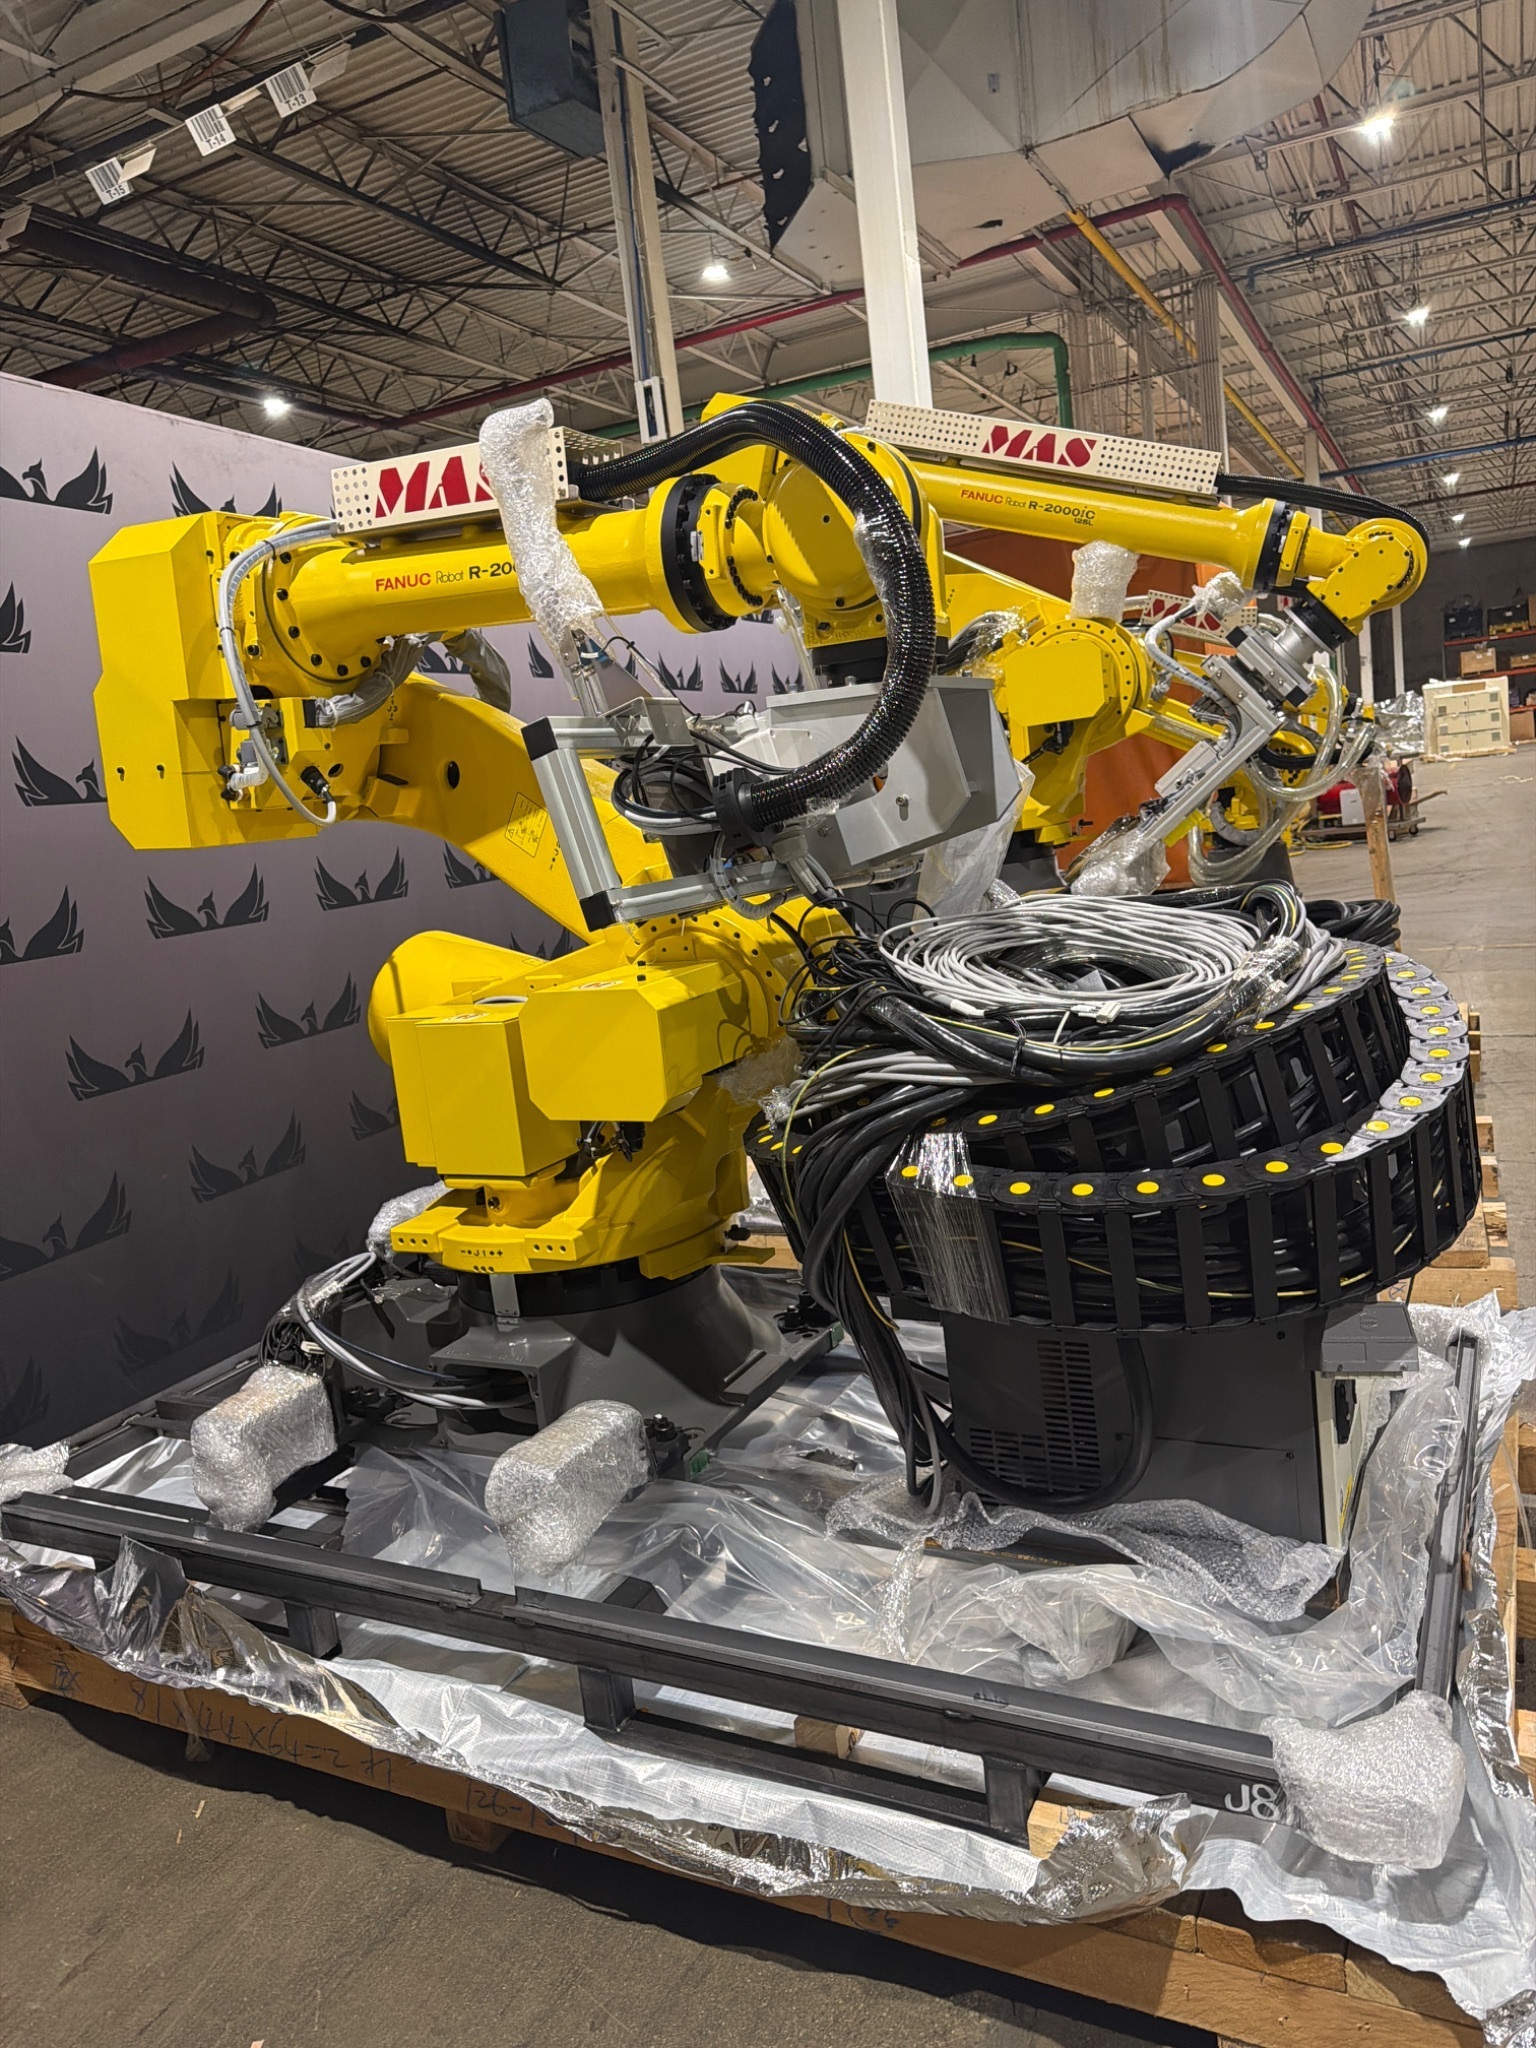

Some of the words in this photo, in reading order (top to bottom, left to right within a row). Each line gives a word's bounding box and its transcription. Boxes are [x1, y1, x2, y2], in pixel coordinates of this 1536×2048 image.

[285, 93, 307, 110] T-13
[206, 133, 227, 149] T-14
[105, 184, 126, 199] T-15
[981, 425, 1097, 467] MAS
[961, 489, 1004, 504] FANUC
[1005, 497, 1026, 508] Robot
[1028, 500, 1096, 519] R-2000iC
[375, 573, 431, 592] FANUC
[436, 570, 464, 584] Robot
[469, 562, 516, 580] R-20
